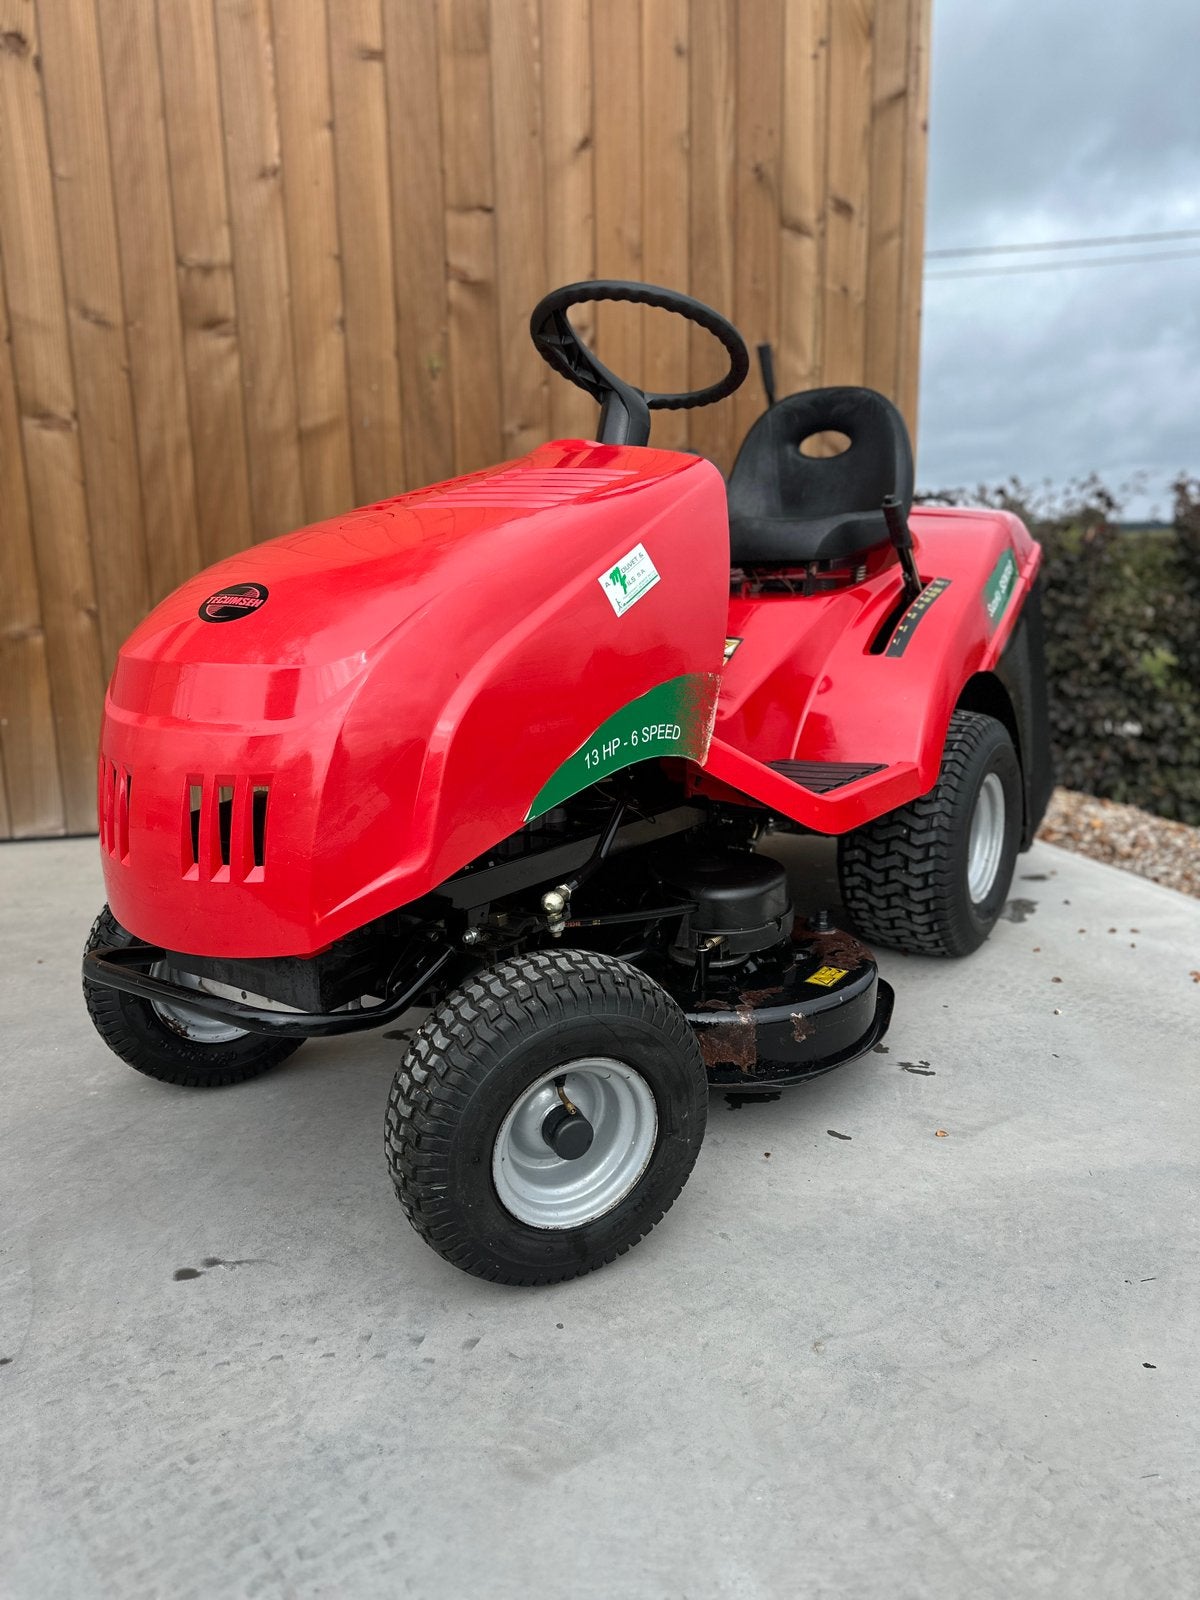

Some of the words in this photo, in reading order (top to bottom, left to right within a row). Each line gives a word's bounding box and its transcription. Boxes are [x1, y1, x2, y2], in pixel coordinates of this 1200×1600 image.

[206, 595, 264, 608] TECUMSEH
[584, 748, 600, 769] 13
[602, 737, 621, 761] HP
[631, 730, 639, 746] 6
[641, 723, 681, 743] SPEED
